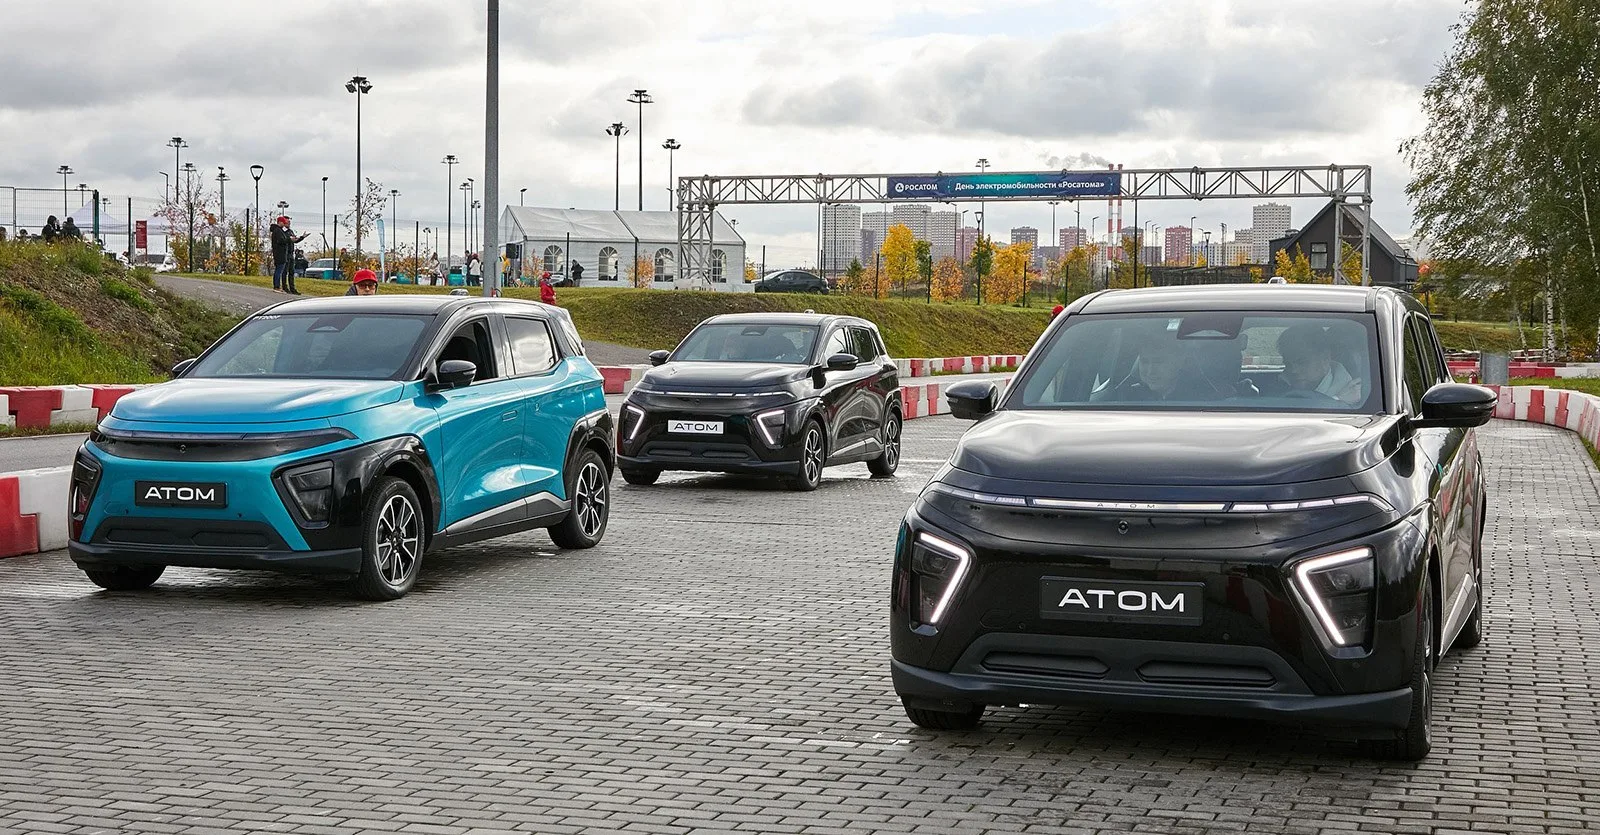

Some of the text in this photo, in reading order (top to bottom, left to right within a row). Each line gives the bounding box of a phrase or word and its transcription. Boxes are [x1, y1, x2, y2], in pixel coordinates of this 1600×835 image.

[904, 183, 938, 191] РОСАТОМ
[954, 180, 1105, 191] День электромобильности «Росатома»
[673, 422, 718, 432] ATOM
[145, 486, 215, 501] ATOM
[1058, 588, 1185, 613] ATOM
